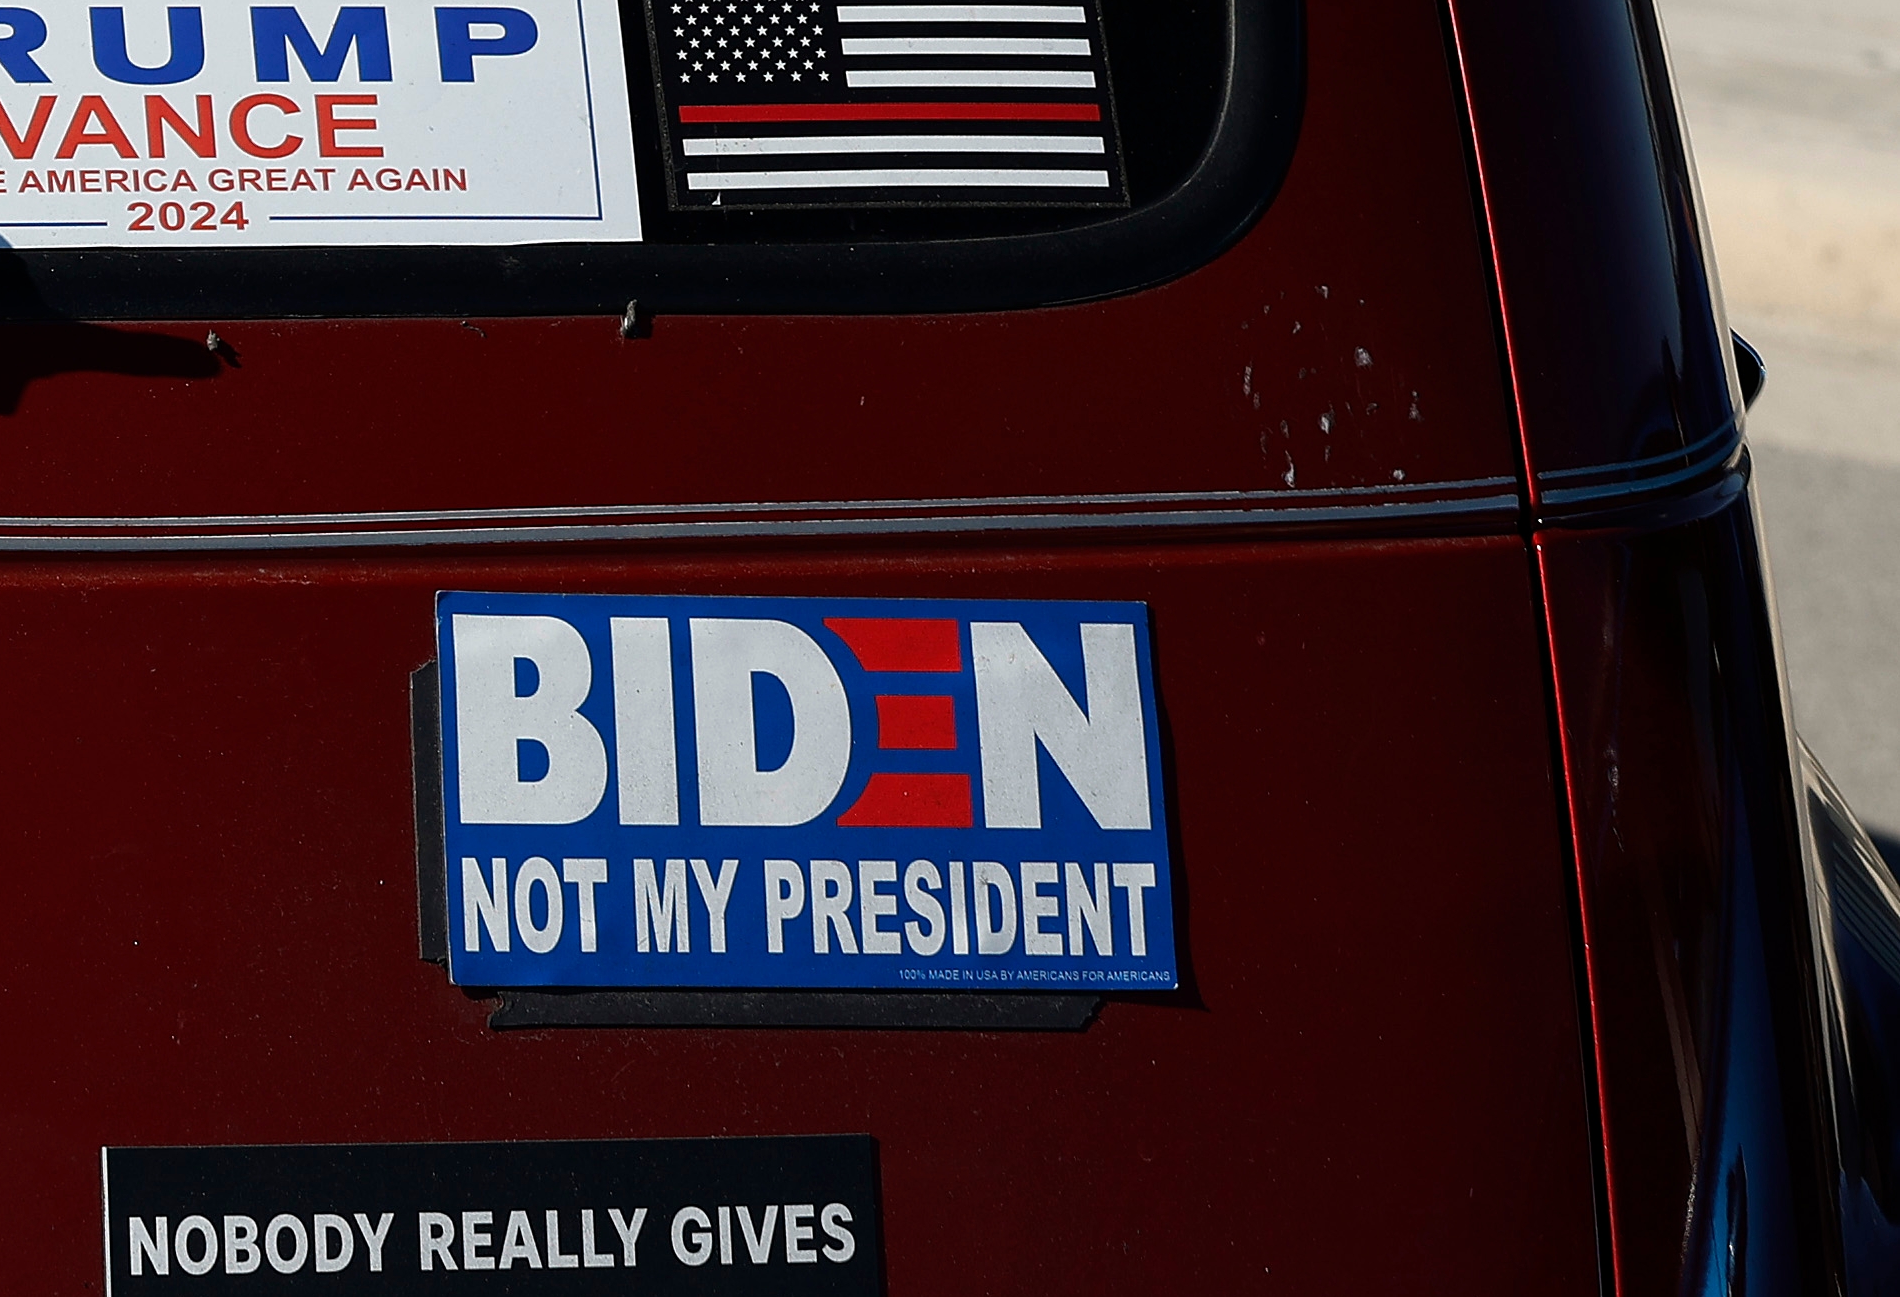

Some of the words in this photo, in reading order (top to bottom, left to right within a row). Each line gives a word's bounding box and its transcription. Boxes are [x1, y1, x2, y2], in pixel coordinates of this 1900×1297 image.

[19, 169, 197, 192] AMERICA
[209, 169, 335, 191] GREAT
[348, 169, 466, 191] AGAIN
[128, 202, 249, 231] 2024
[452, 614, 1151, 830] BIDEN
[462, 857, 607, 953] NOT
[634, 859, 739, 952] MY
[764, 860, 1155, 956] PRESIDENT
[900, 968, 925, 979] 100%
[929, 970, 959, 980] MADE
[963, 970, 973, 980] IN
[976, 970, 998, 980] USA
[1001, 970, 1014, 980] BY
[1017, 970, 1079, 980] AMERICANS
[1083, 971, 1104, 981] FOR
[1107, 971, 1170, 981] AMERICANS
[129, 1213, 394, 1275] NOBODY
[419, 1208, 647, 1270] REALLY
[671, 1203, 855, 1266] GIVES
